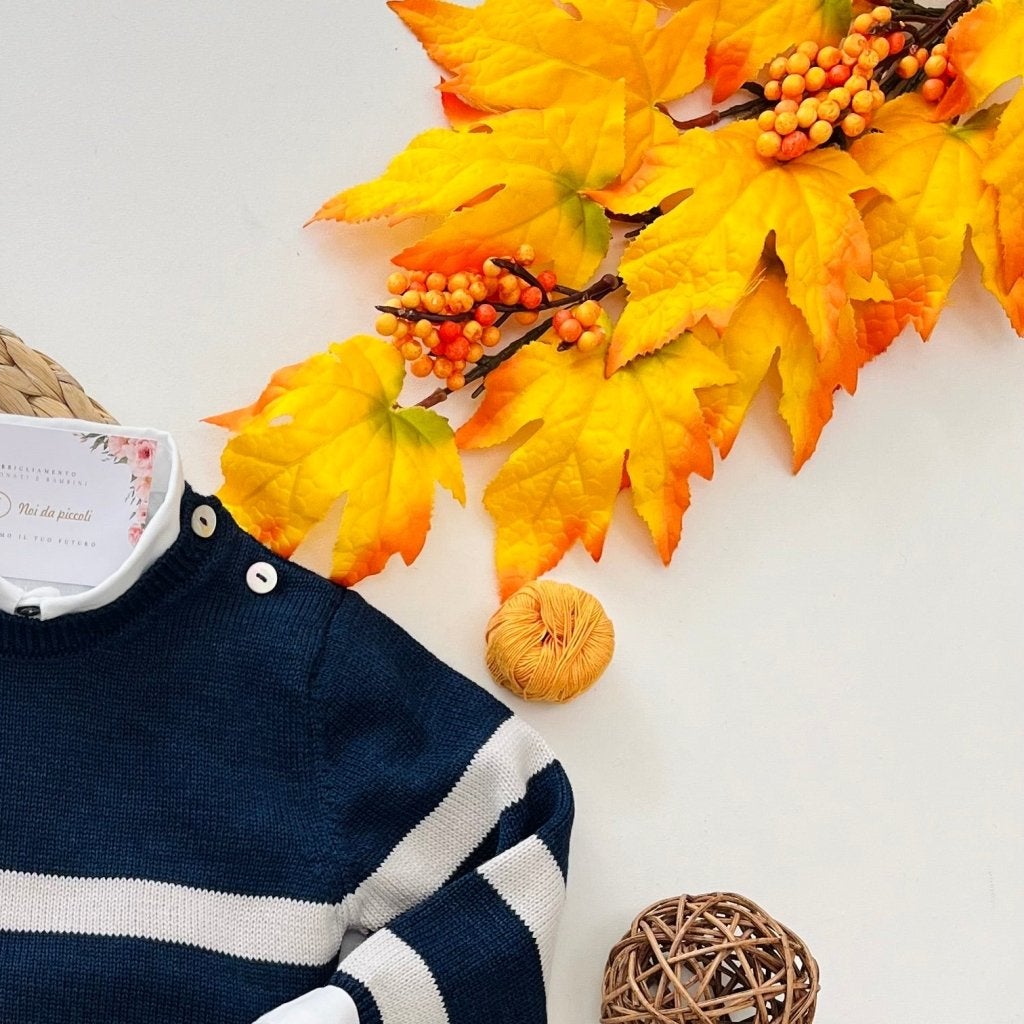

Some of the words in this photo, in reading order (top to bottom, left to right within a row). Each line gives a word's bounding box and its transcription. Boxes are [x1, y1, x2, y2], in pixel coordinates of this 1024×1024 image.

[18, 502, 39, 516] Noi
[40, 505, 55, 518] da
[56, 507, 93, 522] piccoli
